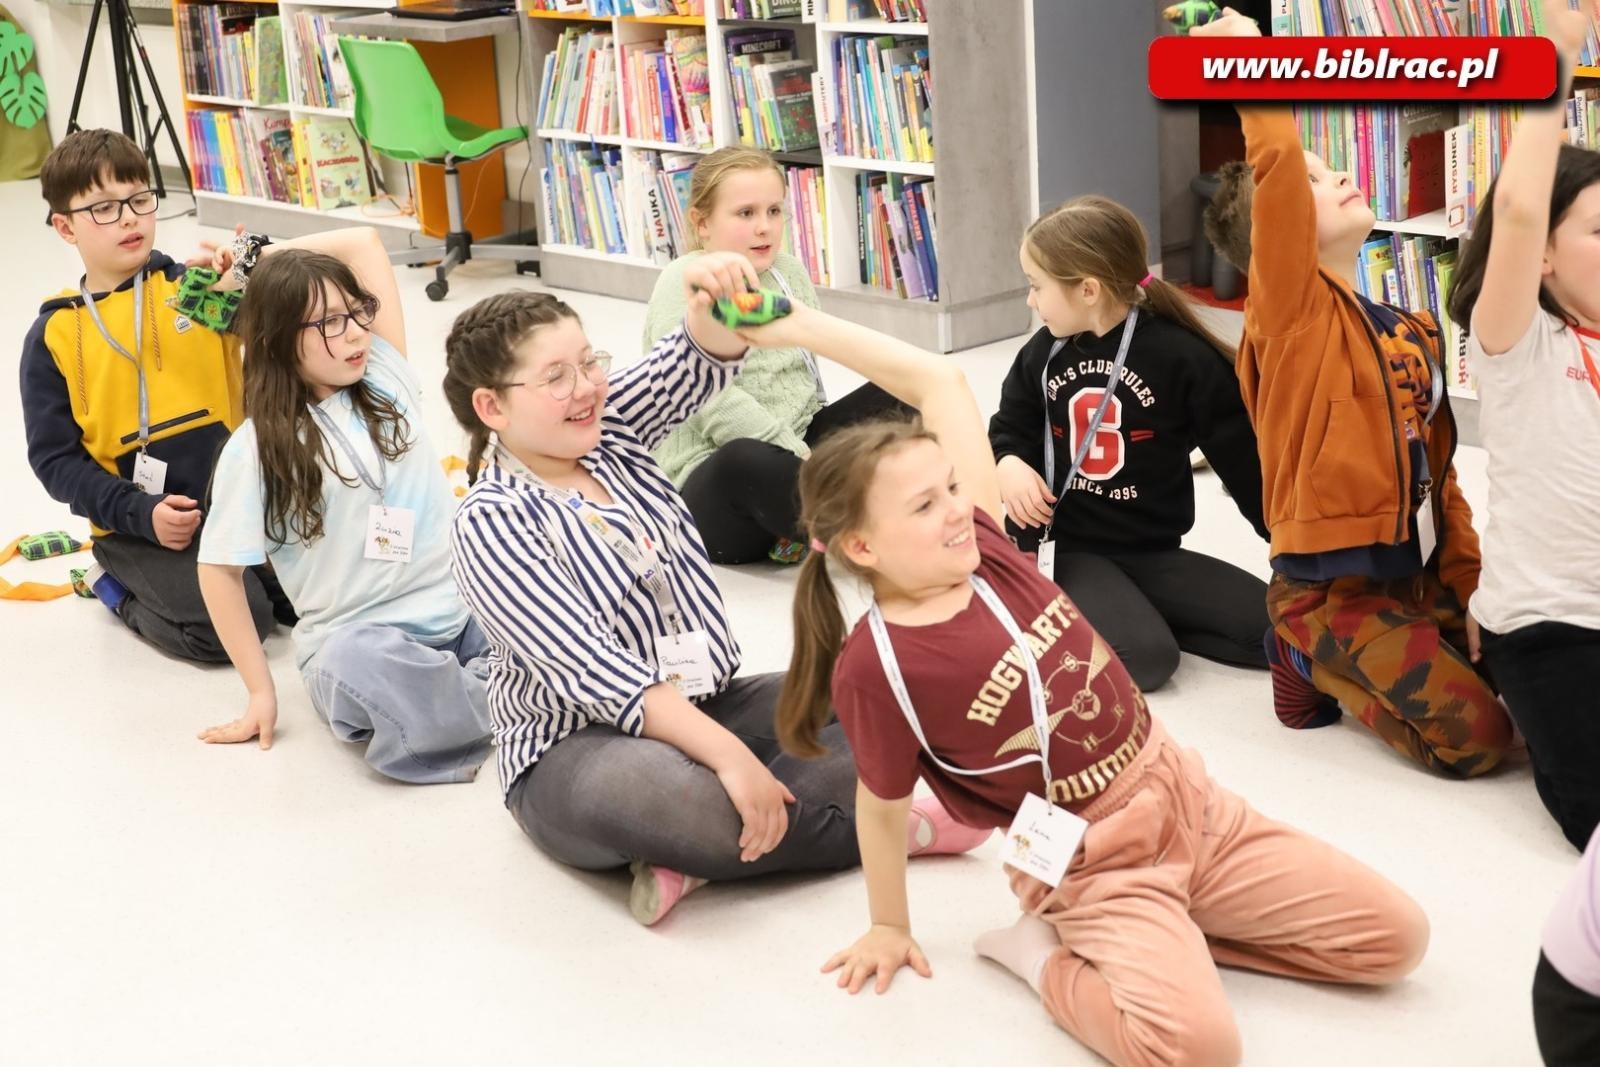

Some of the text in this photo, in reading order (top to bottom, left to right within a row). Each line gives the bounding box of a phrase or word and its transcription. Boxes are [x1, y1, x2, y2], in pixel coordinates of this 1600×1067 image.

[741, 40, 781, 53] MINECRAFT
[648, 188, 665, 238] NAUKA
[1078, 359, 1115, 375] CLUB
[966, 593, 1080, 727] HOGWARTS
